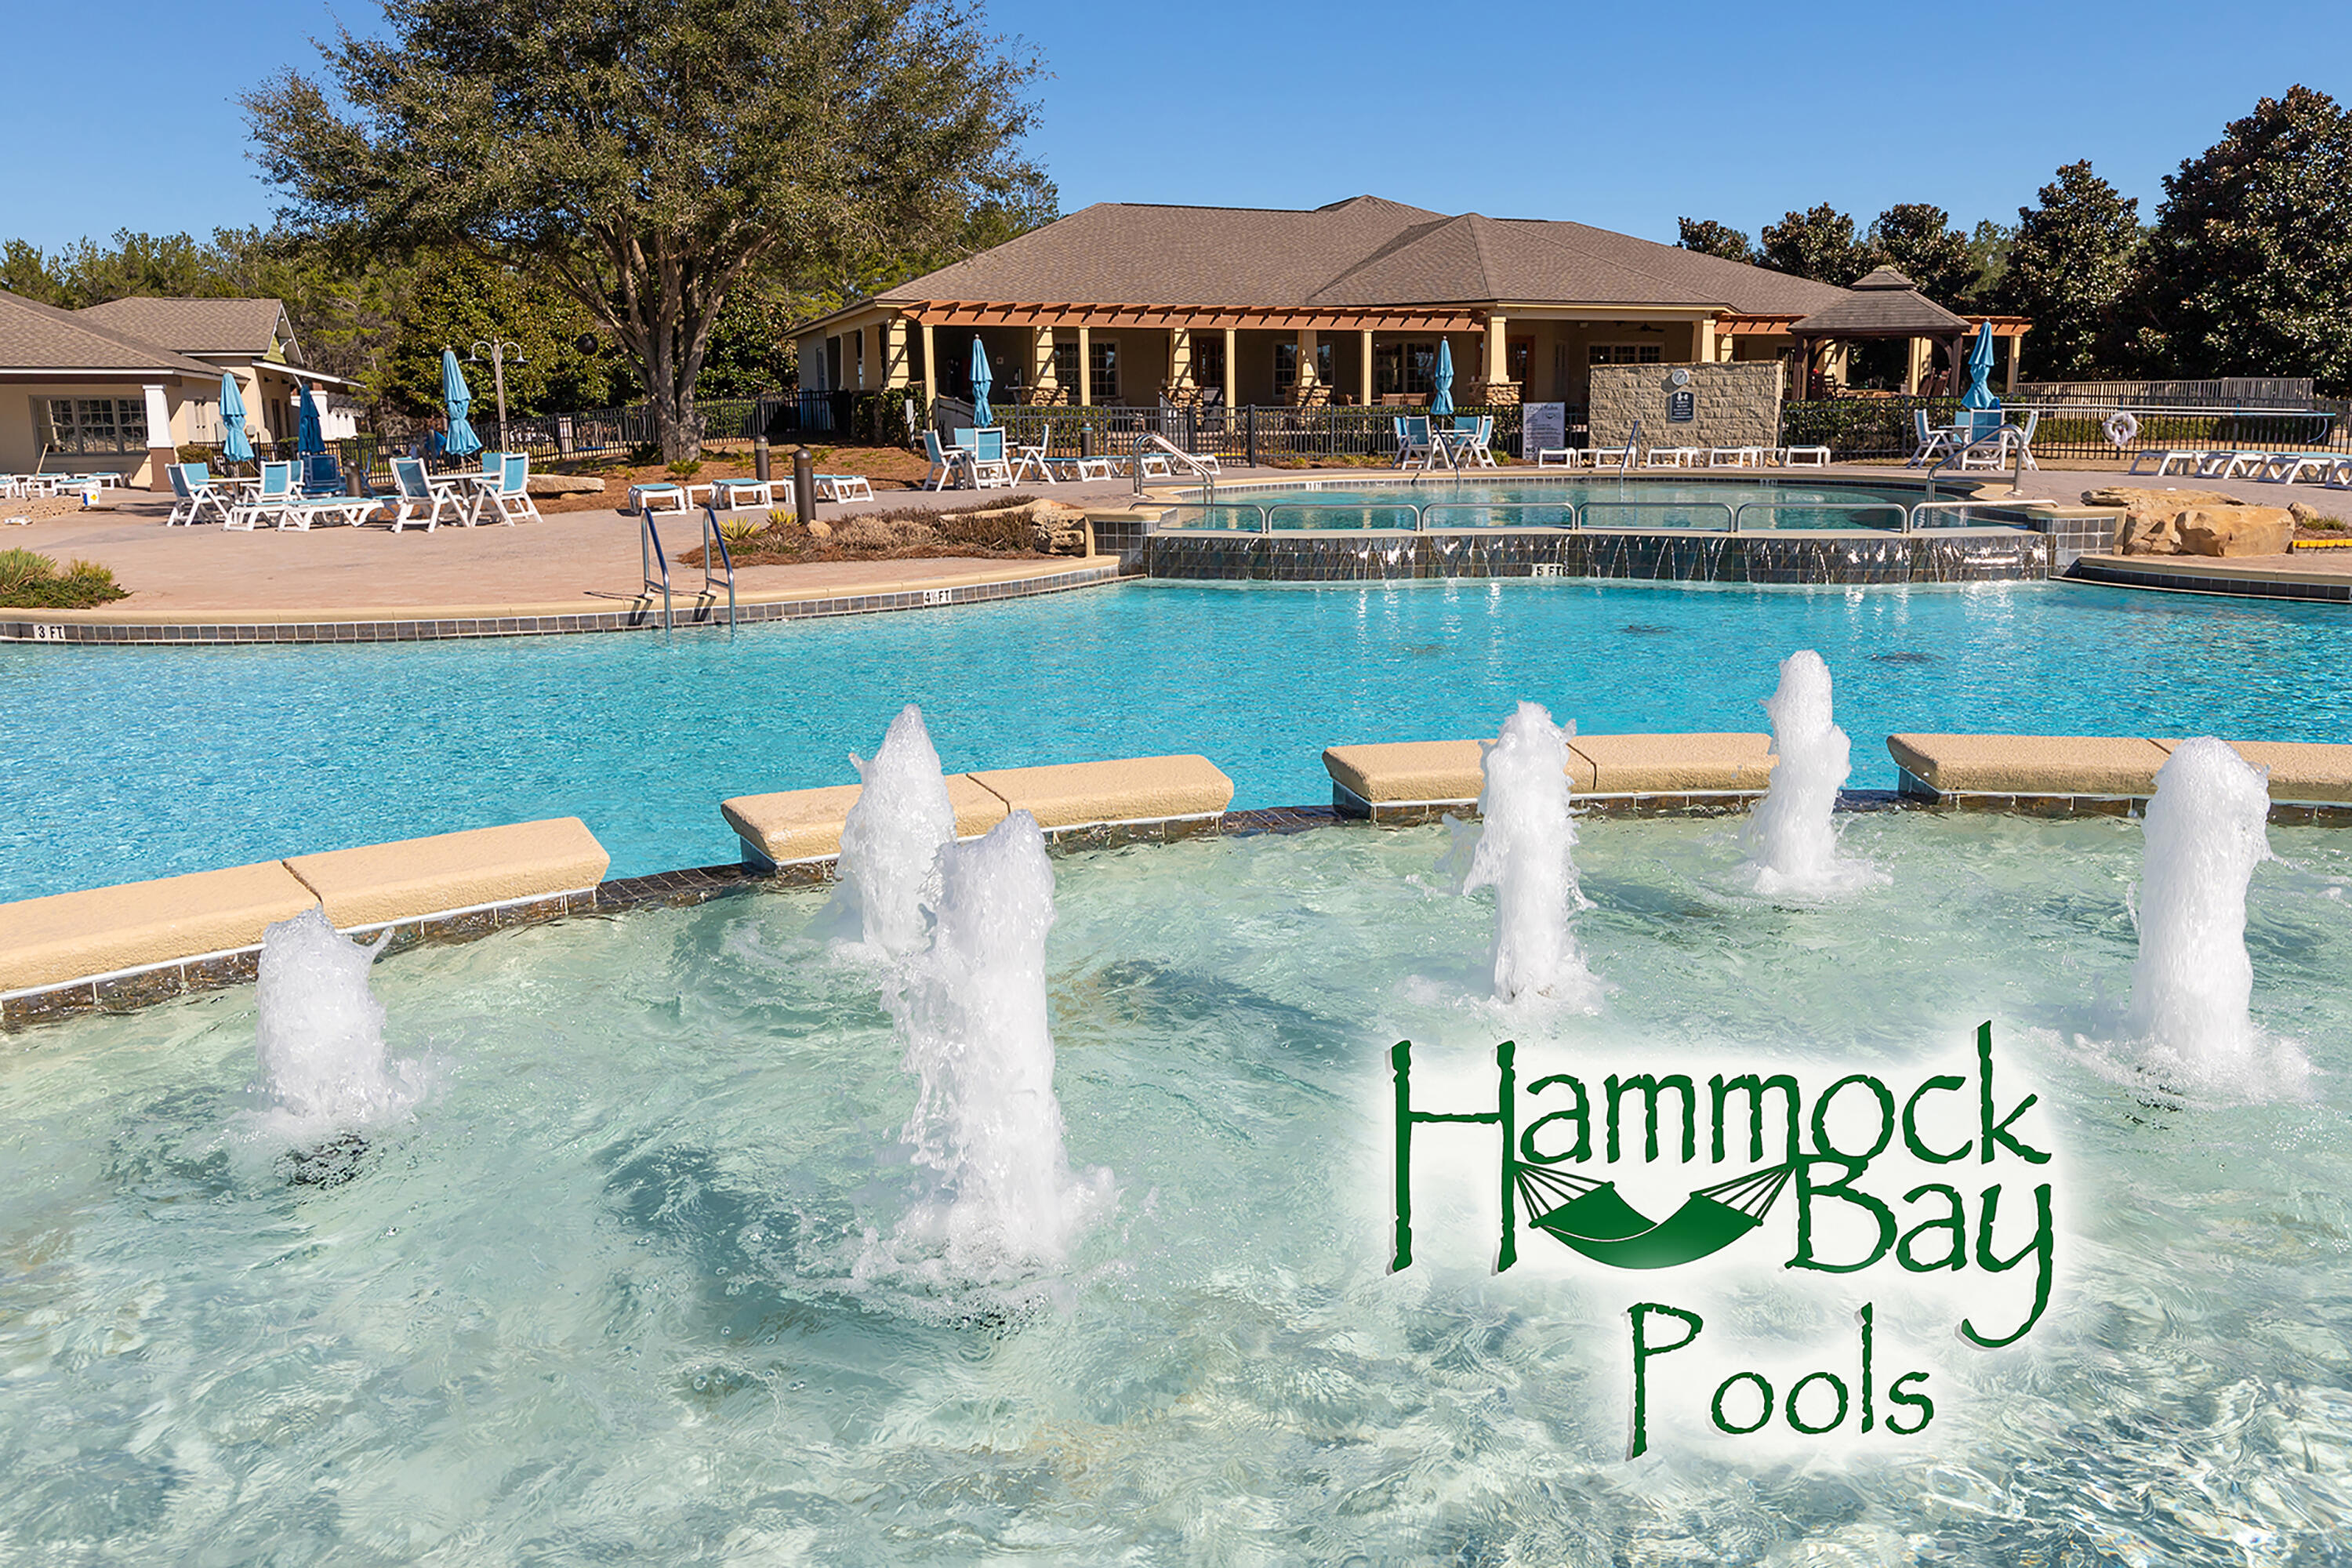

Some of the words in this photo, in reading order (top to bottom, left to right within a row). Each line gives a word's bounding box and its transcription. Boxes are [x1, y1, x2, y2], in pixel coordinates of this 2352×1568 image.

[1537, 566, 1543, 576] 5
[938, 590, 949, 602] FT
[38, 625, 45, 638] 3
[49, 626, 64, 639] FT
